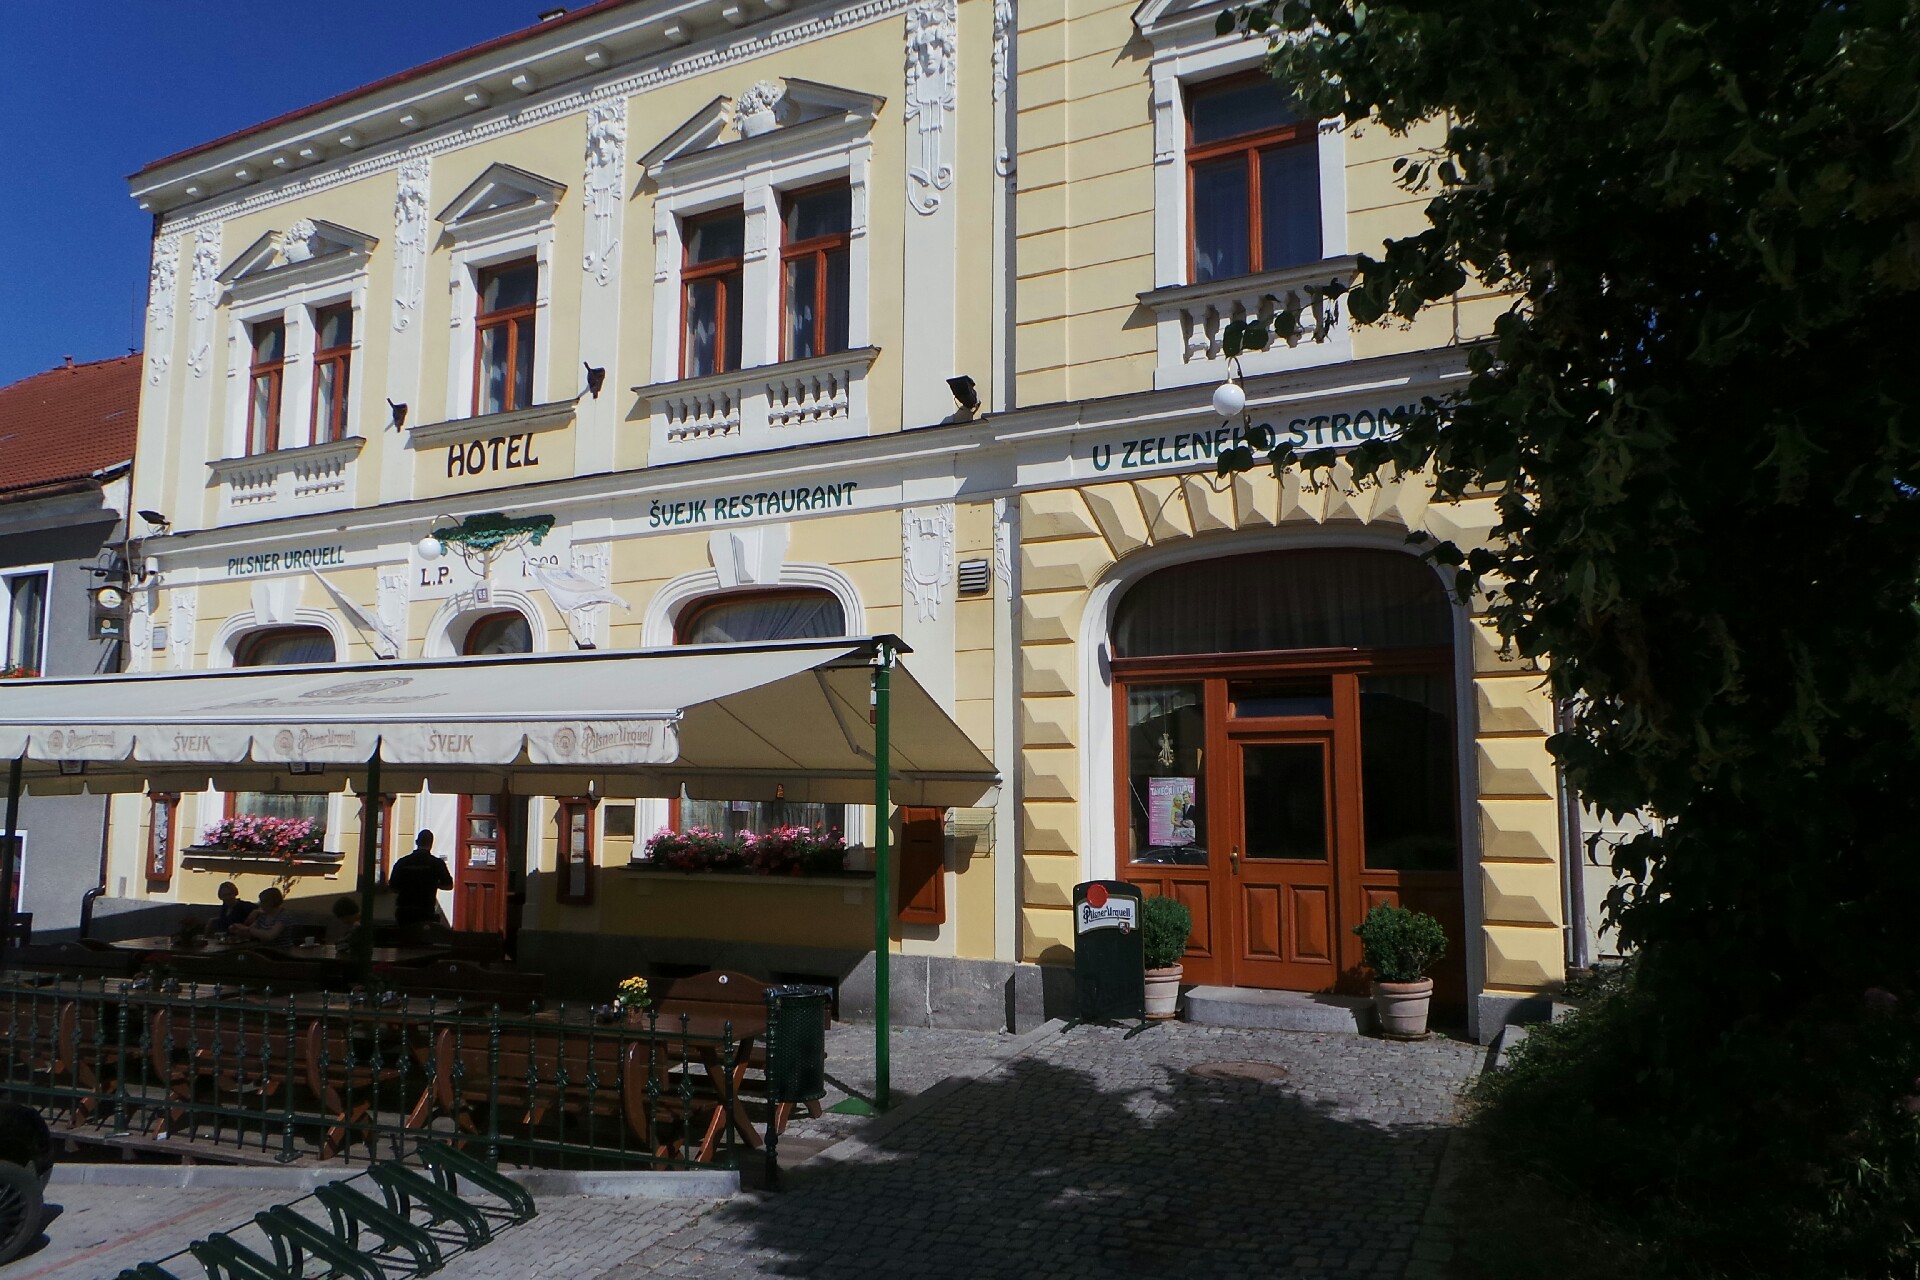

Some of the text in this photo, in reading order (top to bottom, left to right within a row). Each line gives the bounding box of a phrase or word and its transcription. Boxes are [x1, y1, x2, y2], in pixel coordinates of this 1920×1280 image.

[447, 433, 539, 478] HOTEL
[1093, 445, 1111, 472] U
[650, 482, 858, 528] ŠVEJK RESTAURANT
[227, 545, 345, 576] PILSNER URQUELL
[421, 566, 453, 586] L.P.
[174, 732, 211, 752] ŠVEJK
[427, 730, 473, 752] ŠVEJK
[581, 725, 654, 756] Pilsner Urquell
[1083, 905, 1131, 924] Pilsner Urquell
